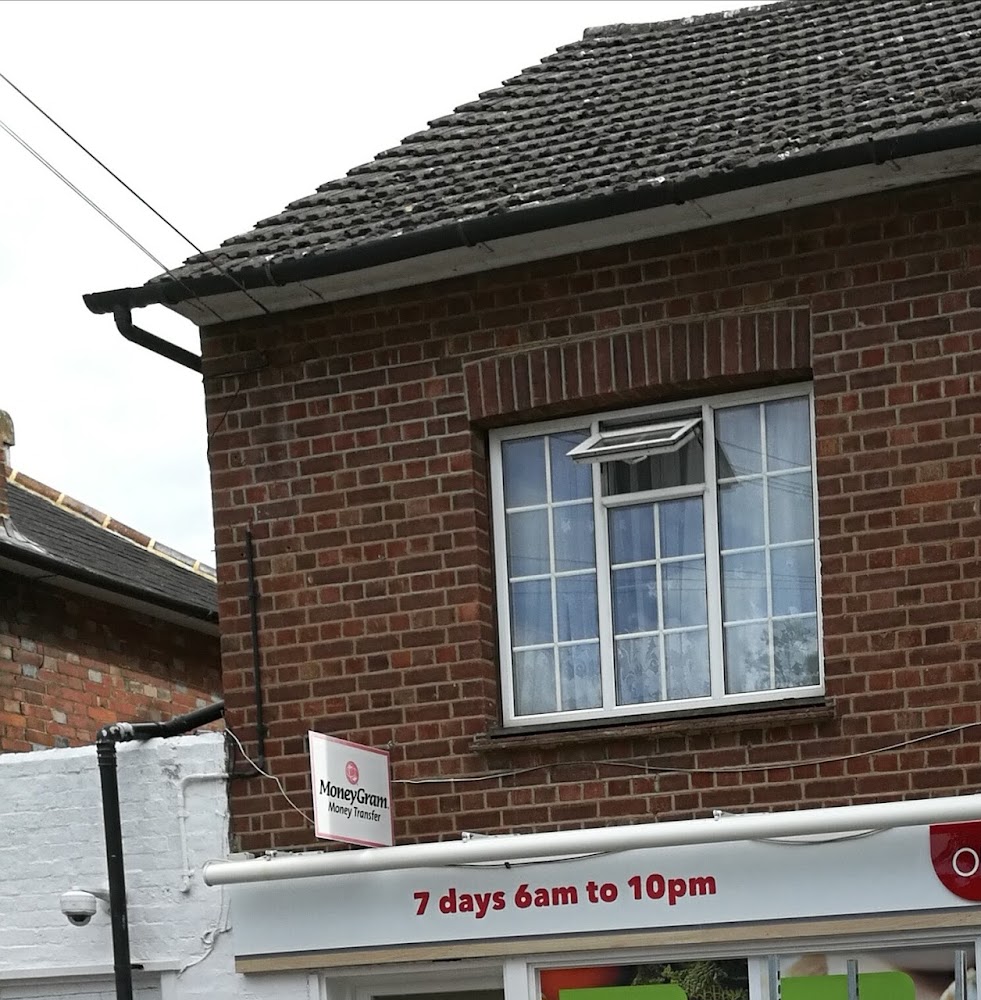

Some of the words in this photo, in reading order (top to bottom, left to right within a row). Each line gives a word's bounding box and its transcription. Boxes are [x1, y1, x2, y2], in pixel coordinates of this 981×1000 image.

[319, 779, 388, 809] MoneyGram
[327, 801, 352, 819] Money
[353, 806, 381, 822] Transfer
[413, 891, 430, 916] 7
[438, 888, 506, 919] days
[514, 884, 578, 909] 6am
[586, 881, 618, 903] to
[627, 874, 717, 906] 10pm
